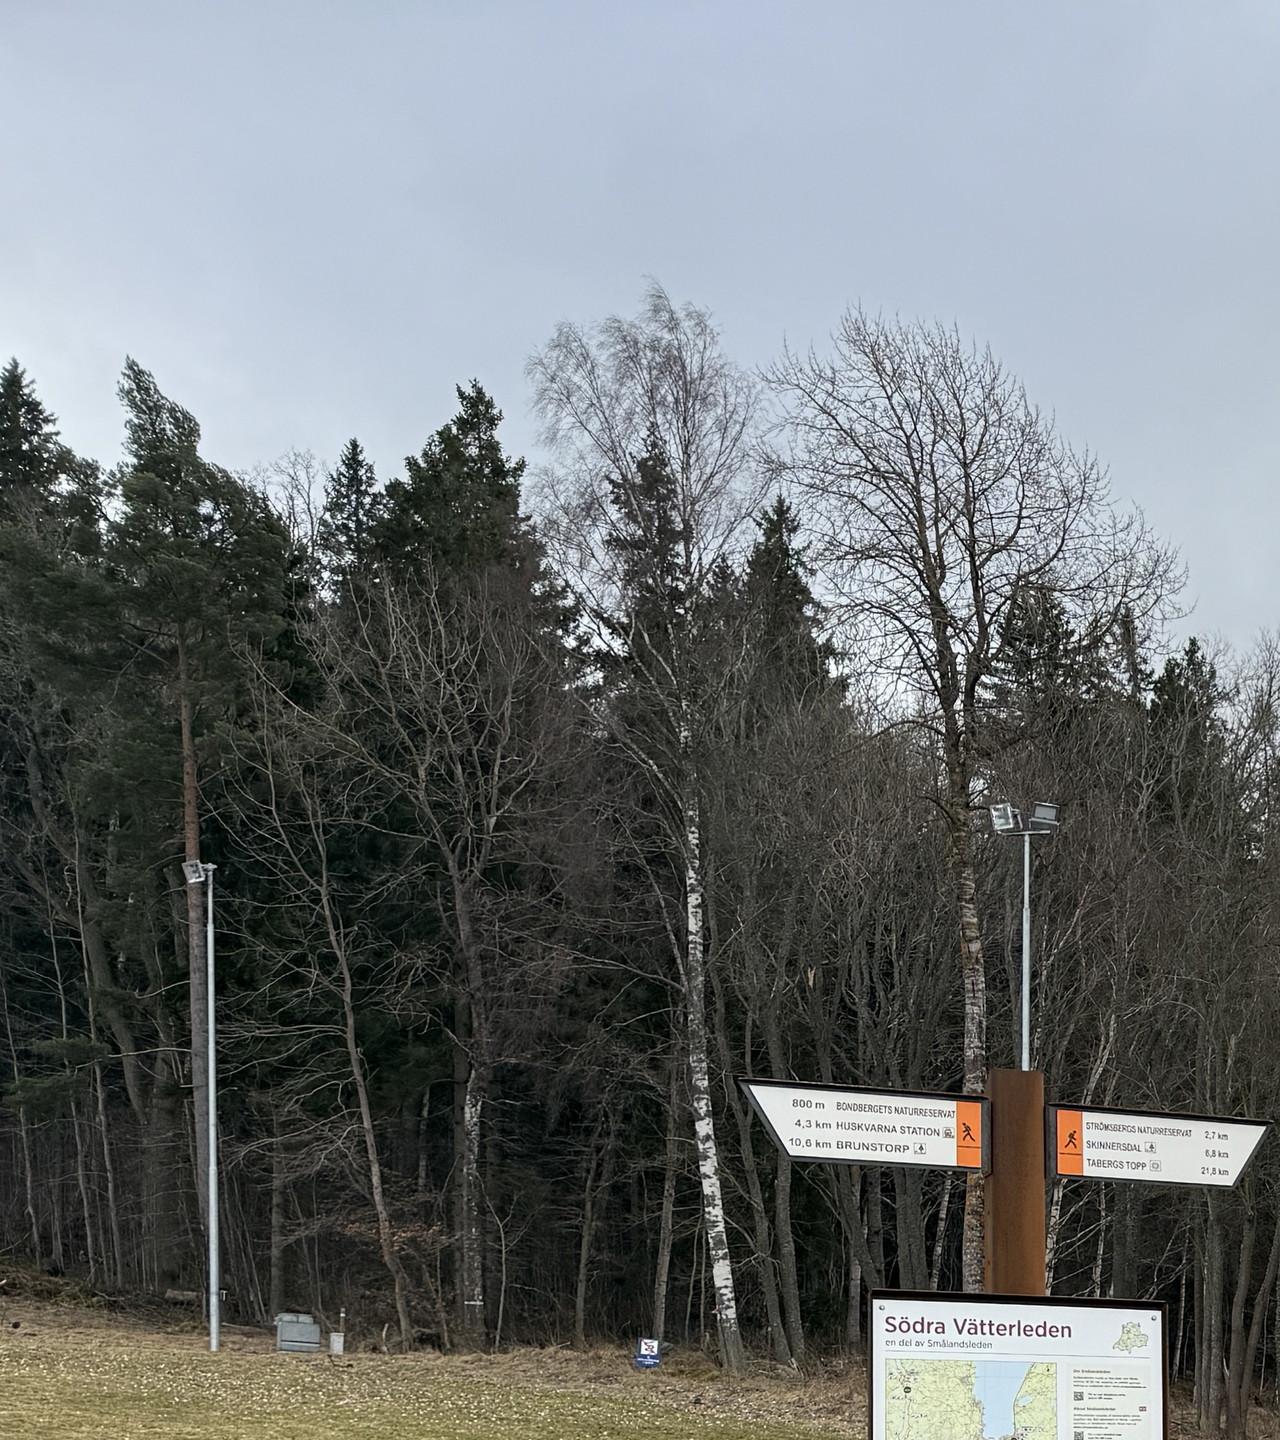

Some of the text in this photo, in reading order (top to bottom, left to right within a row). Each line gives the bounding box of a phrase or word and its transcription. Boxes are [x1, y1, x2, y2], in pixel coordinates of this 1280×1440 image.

[792, 1098, 955, 1119] 800 m BONDBERGETS NATURRESERVAT
[794, 1119, 940, 1137] 4,3 km HUSKVARNA STATION
[1086, 1121, 1229, 1141] STRÖMSBERGS NATURRESERVAT 2,7 km
[788, 1137, 910, 1154] 10,6 km BRUNSTORP
[1086, 1141, 1229, 1159] SKINNERSDAL 6,8 km
[1086, 1158, 1230, 1176] TABERGS TOPP 21,8 km
[885, 1316, 1072, 1339] Södra Vätterleden
[885, 1338, 993, 1350] en del av Smålandsleden
